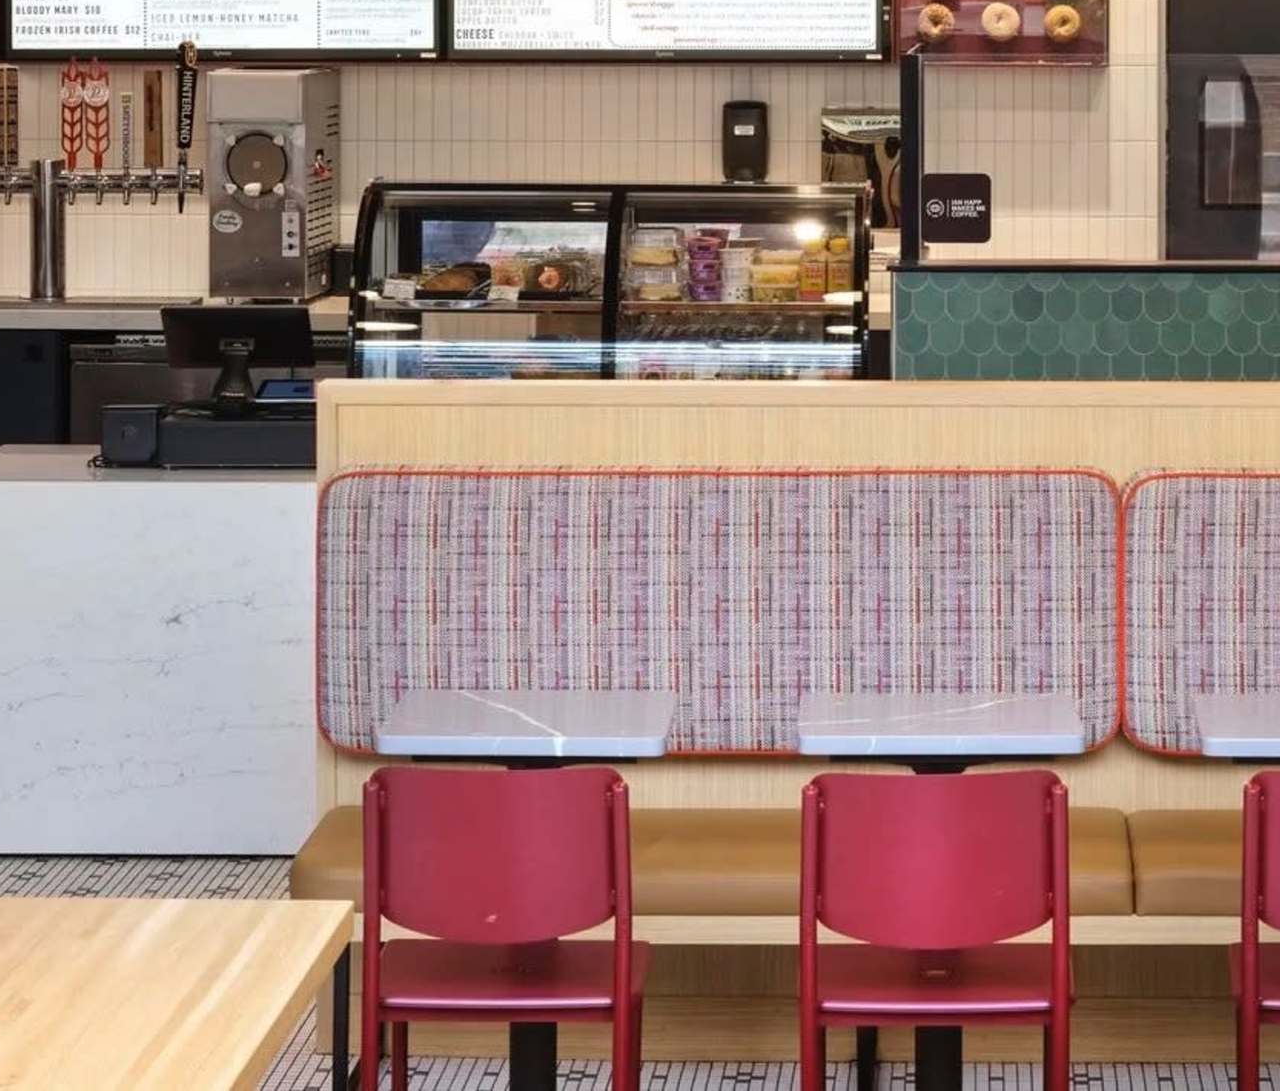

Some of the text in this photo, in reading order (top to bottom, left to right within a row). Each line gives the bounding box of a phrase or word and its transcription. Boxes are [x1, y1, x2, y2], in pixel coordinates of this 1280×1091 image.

[15, 5, 51, 16] BLOODY
[53, 5, 79, 16] MARY
[15, 25, 51, 36] FROZEN
[54, 25, 81, 36] IRISH
[83, 25, 119, 36] COFFEE
[124, 25, 141, 36] $12
[455, 29, 496, 40] CHEESE
[180, 70, 193, 144] HINTERLAND
